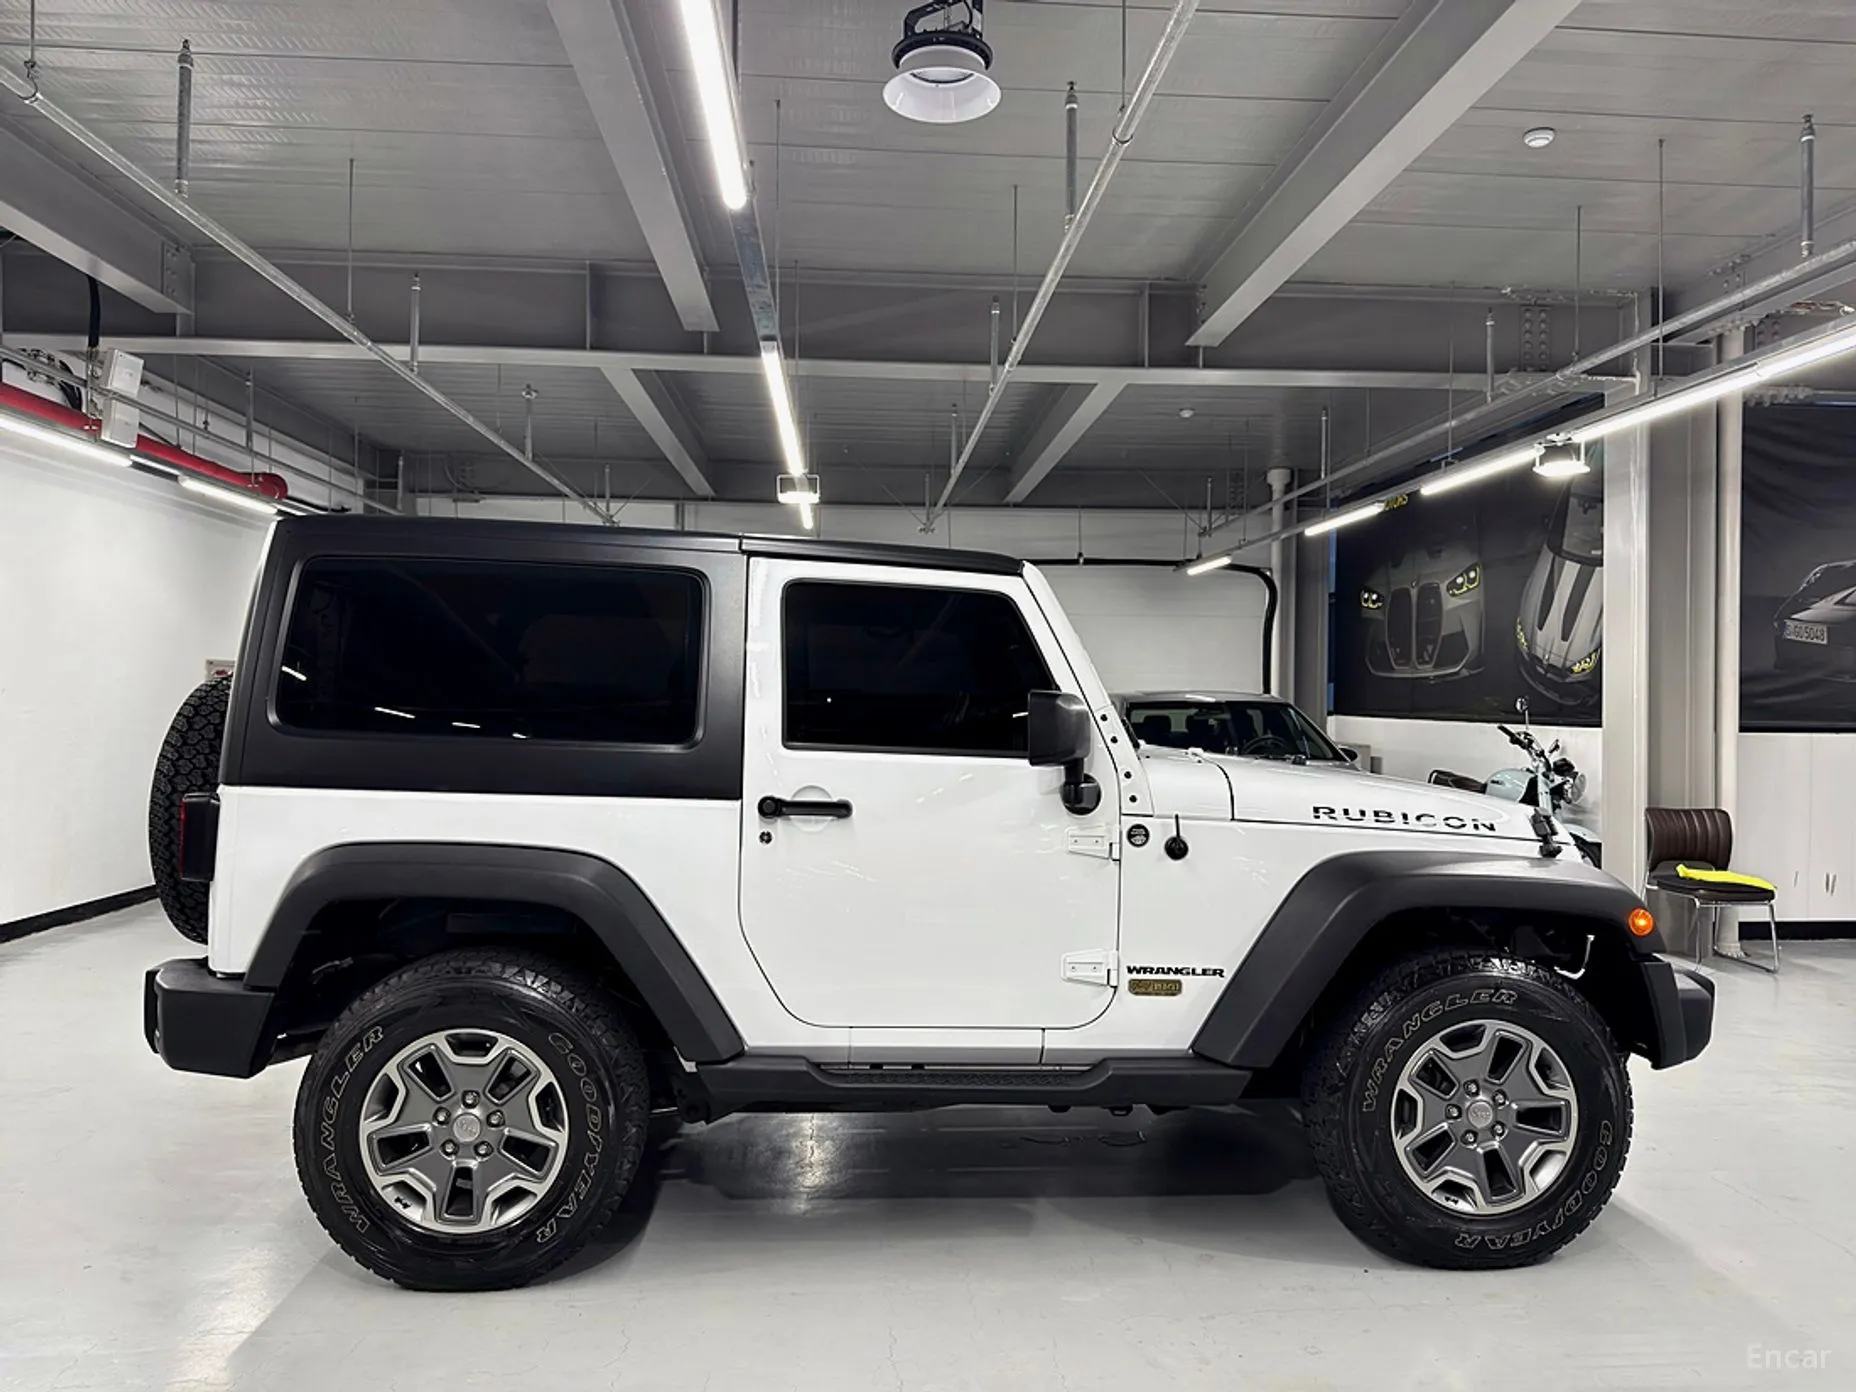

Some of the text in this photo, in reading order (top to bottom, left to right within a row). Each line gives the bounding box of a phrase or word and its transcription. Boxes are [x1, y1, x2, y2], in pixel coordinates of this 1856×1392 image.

[1312, 806, 1496, 832] RUBICON
[1126, 965, 1225, 978] WRANGLER
[1362, 989, 1518, 1112] WRANGLER
[319, 1025, 385, 1233] WRANGLER
[536, 1033, 604, 1243] GOODYEAR
[1454, 1120, 1613, 1249] GOODYEAR
